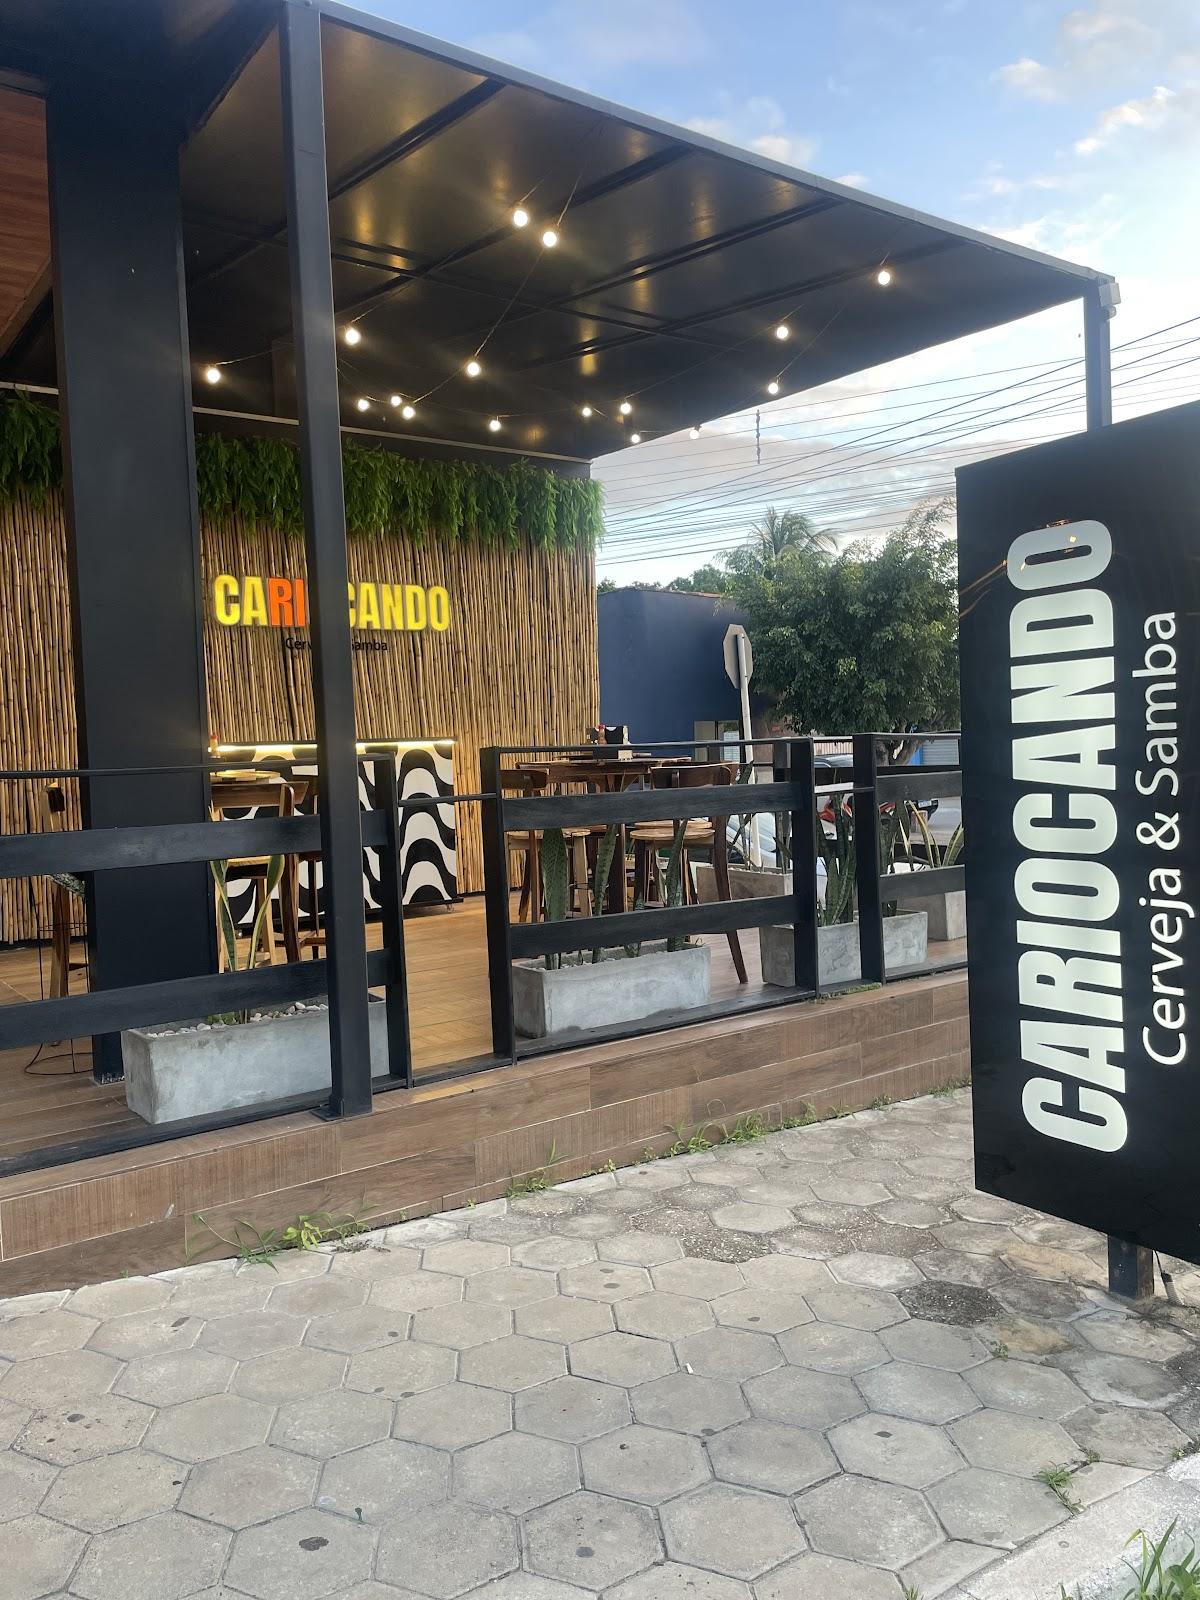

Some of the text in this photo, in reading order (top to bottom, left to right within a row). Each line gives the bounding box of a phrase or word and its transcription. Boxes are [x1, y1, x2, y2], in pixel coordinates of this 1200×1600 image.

[214, 574, 450, 631] CARIANDO
[351, 638, 388, 651] amba
[1007, 519, 1127, 1152] CARIOCANDO
[1132, 611, 1195, 1066] Cerveja & Samba
